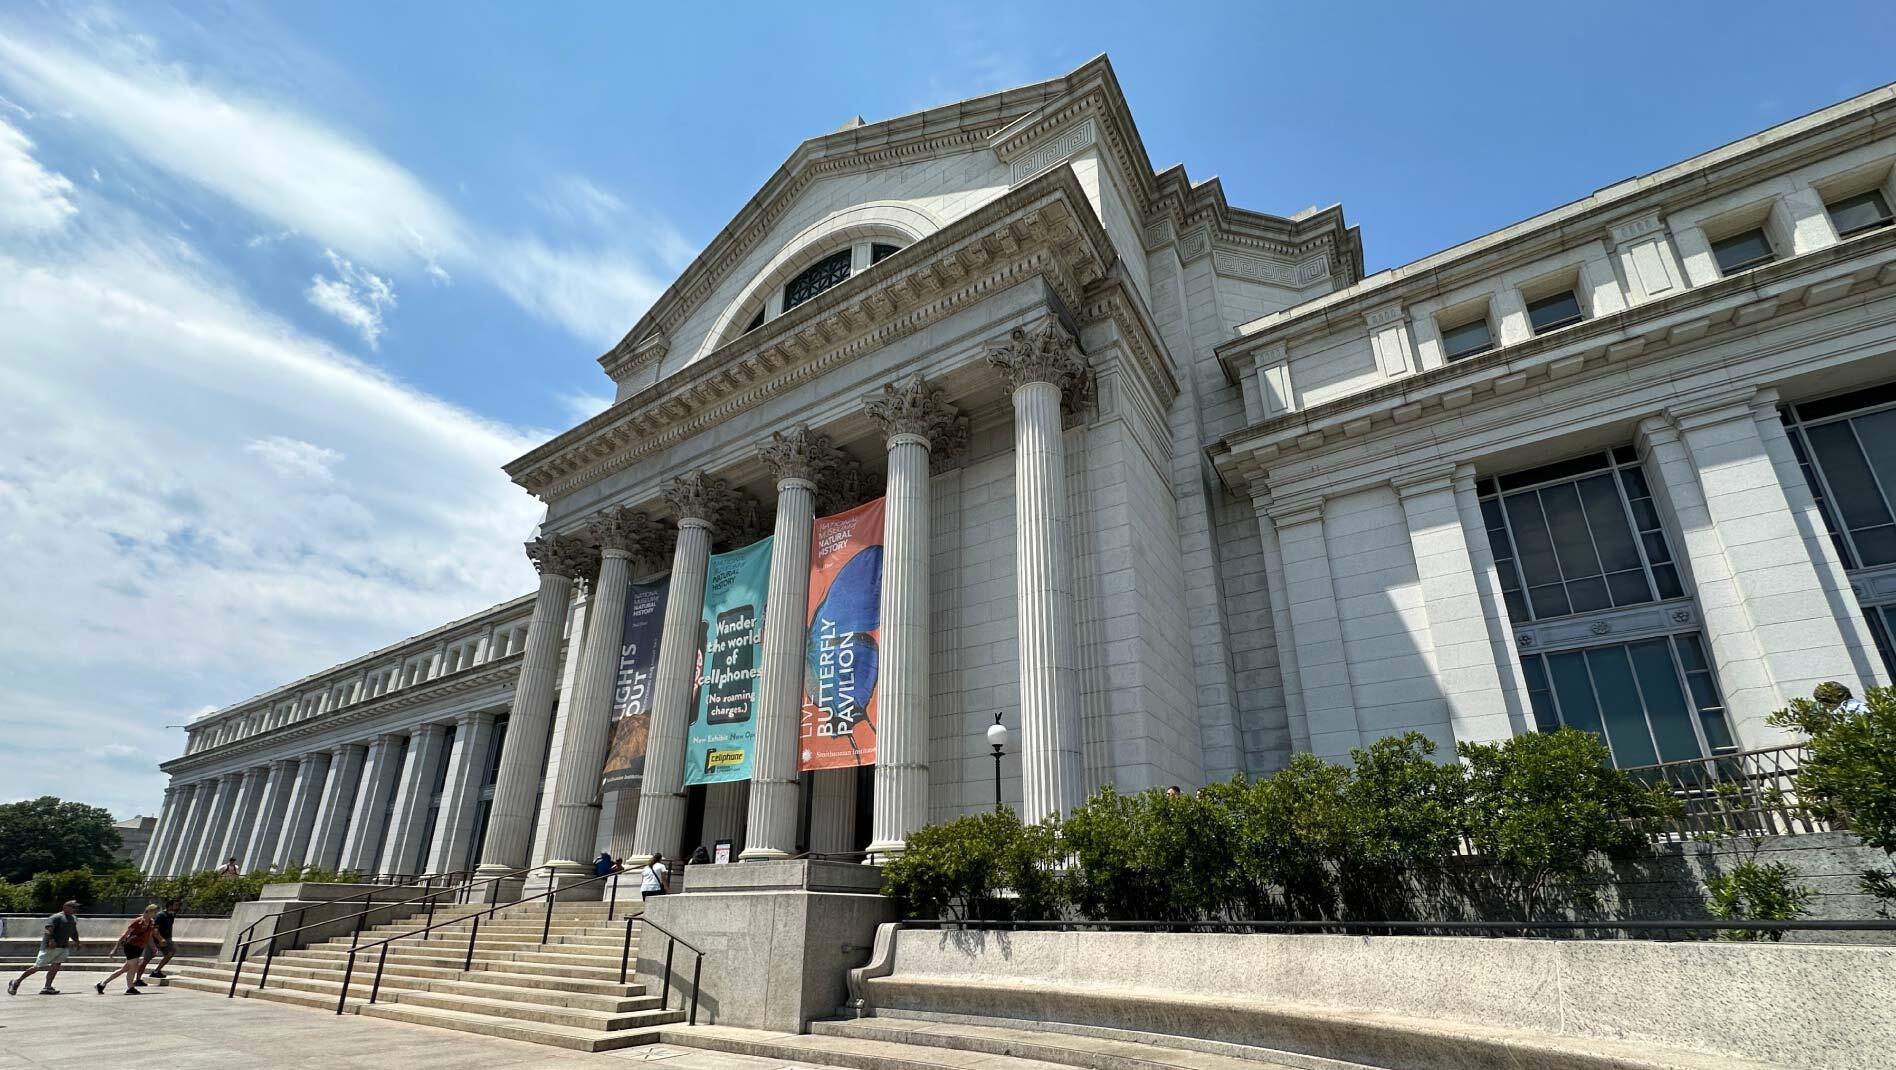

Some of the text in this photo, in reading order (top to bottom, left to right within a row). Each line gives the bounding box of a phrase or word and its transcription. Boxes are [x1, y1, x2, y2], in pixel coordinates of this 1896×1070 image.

[818, 530, 852, 549] NATURAL
[818, 539, 849, 558] HISTORY
[632, 607, 654, 616] HISTORY
[633, 601, 656, 611] NATURAL
[716, 614, 757, 636] Wander
[706, 629, 761, 653] the world
[726, 648, 739, 665] of
[698, 667, 763, 689] cellphones
[817, 618, 836, 737] BUTTERFLY
[837, 631, 854, 735] PAVILION
[625, 671, 647, 717] OUT
[705, 690, 756, 704] (No roaming
[711, 702, 748, 718] charges.)
[800, 694, 814, 739] LIVE
[710, 753, 743, 763] cellphone
[815, 750, 852, 759] Smithsonian
